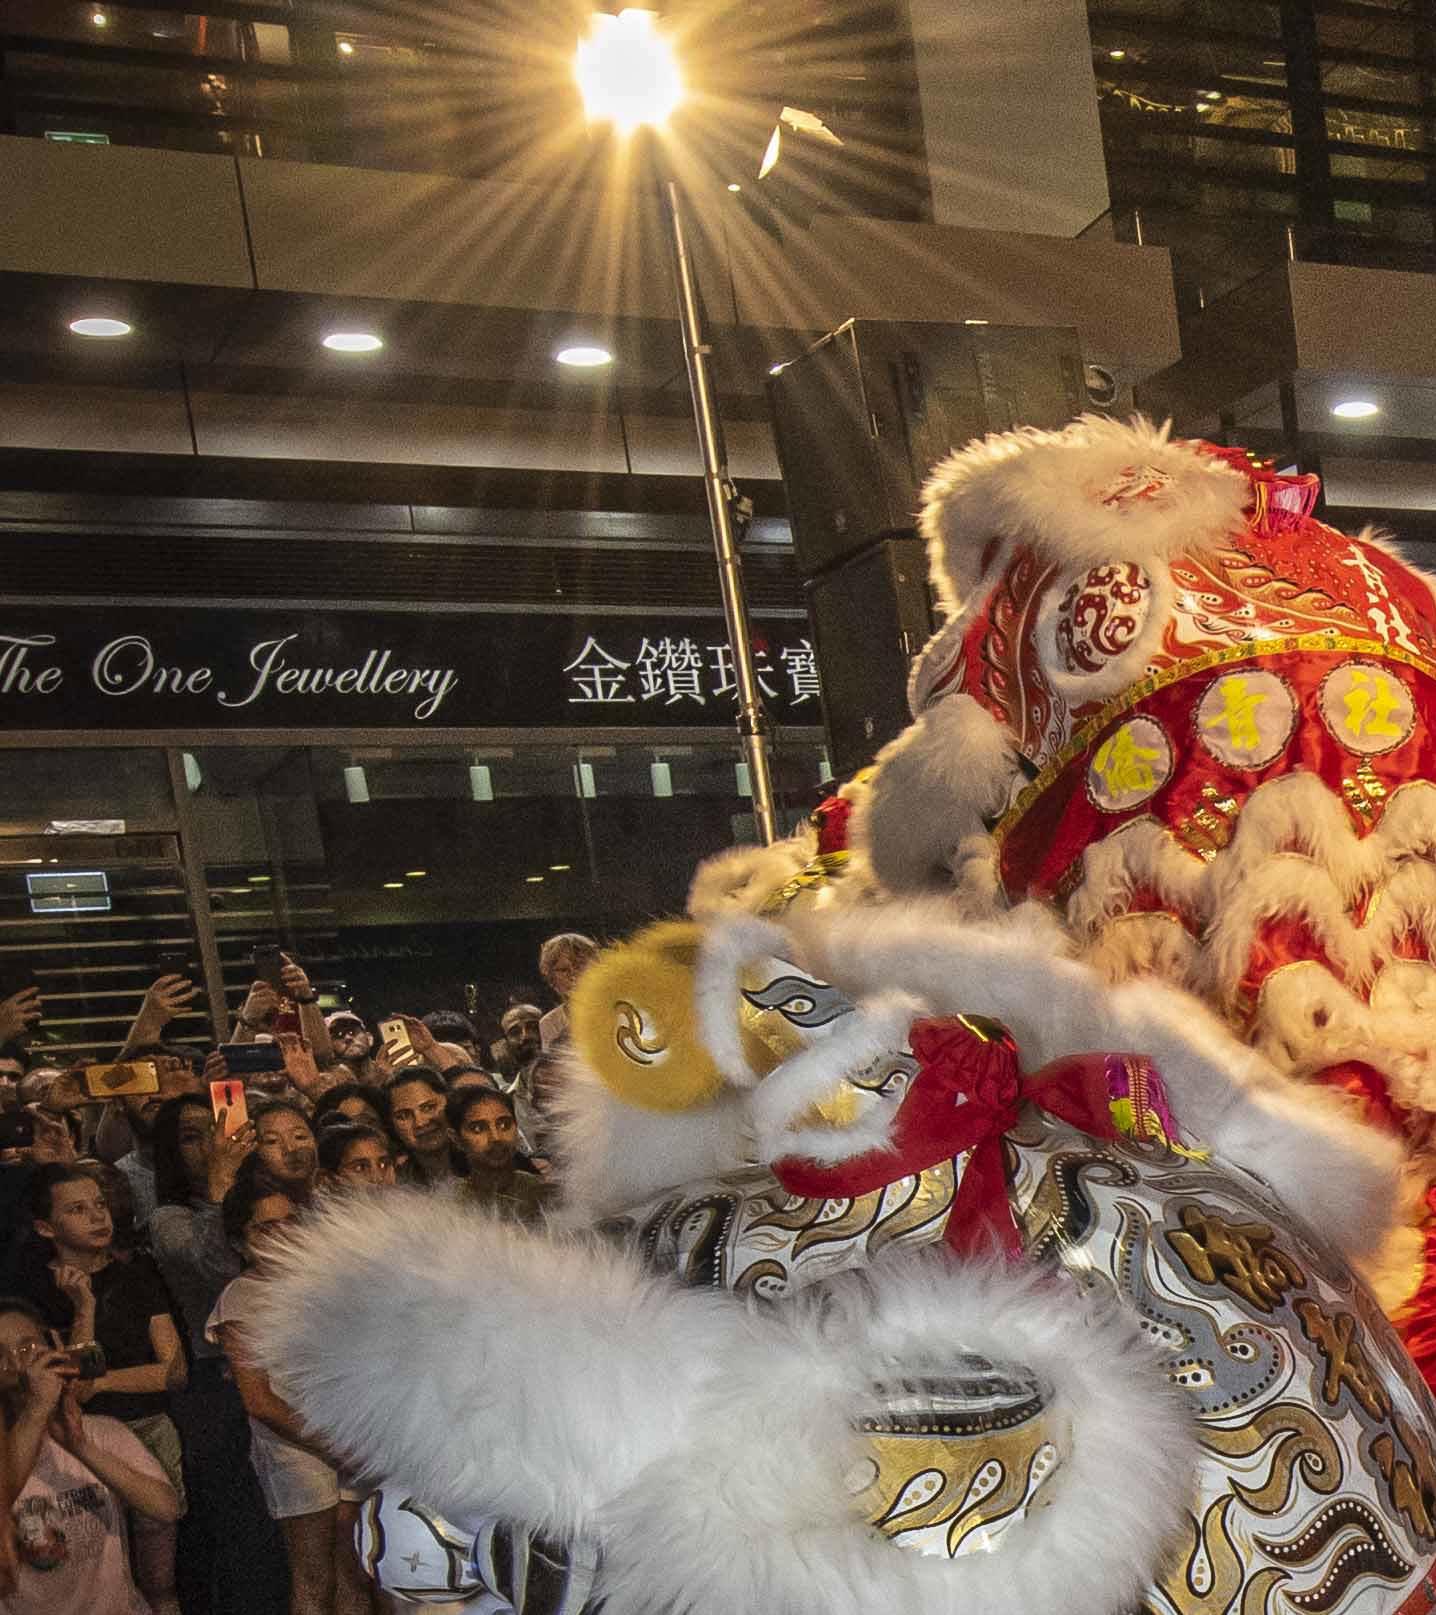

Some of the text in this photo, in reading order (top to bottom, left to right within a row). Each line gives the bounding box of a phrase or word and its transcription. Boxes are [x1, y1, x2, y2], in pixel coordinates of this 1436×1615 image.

[0, 633, 459, 720] The One Jewellery
